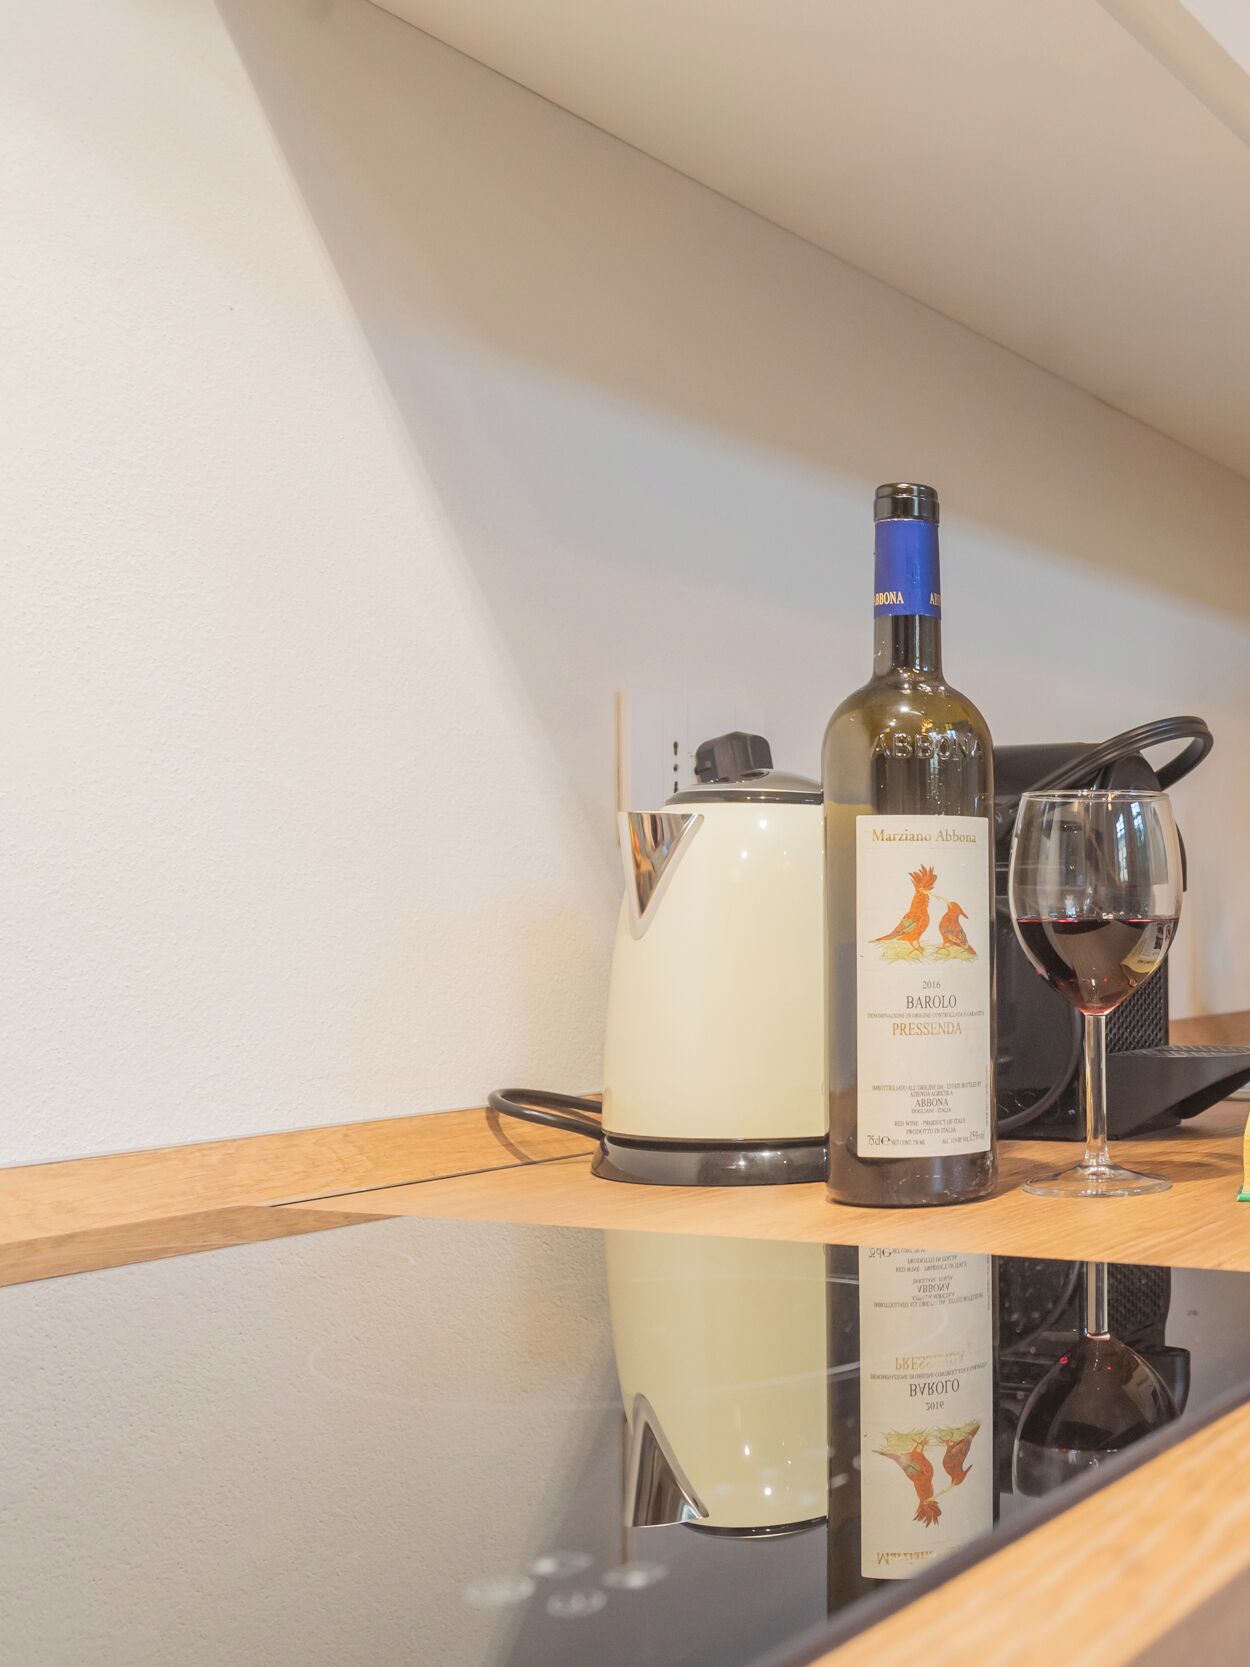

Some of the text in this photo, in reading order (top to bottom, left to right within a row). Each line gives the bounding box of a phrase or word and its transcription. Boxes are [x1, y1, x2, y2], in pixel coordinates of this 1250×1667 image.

[872, 829, 977, 843] Marziano Abbona
[922, 980, 941, 990] 2016
[906, 994, 957, 1009] BAROLO
[892, 1021, 962, 1036] PRESSENDA
[914, 1098, 949, 1108] ABBONA
